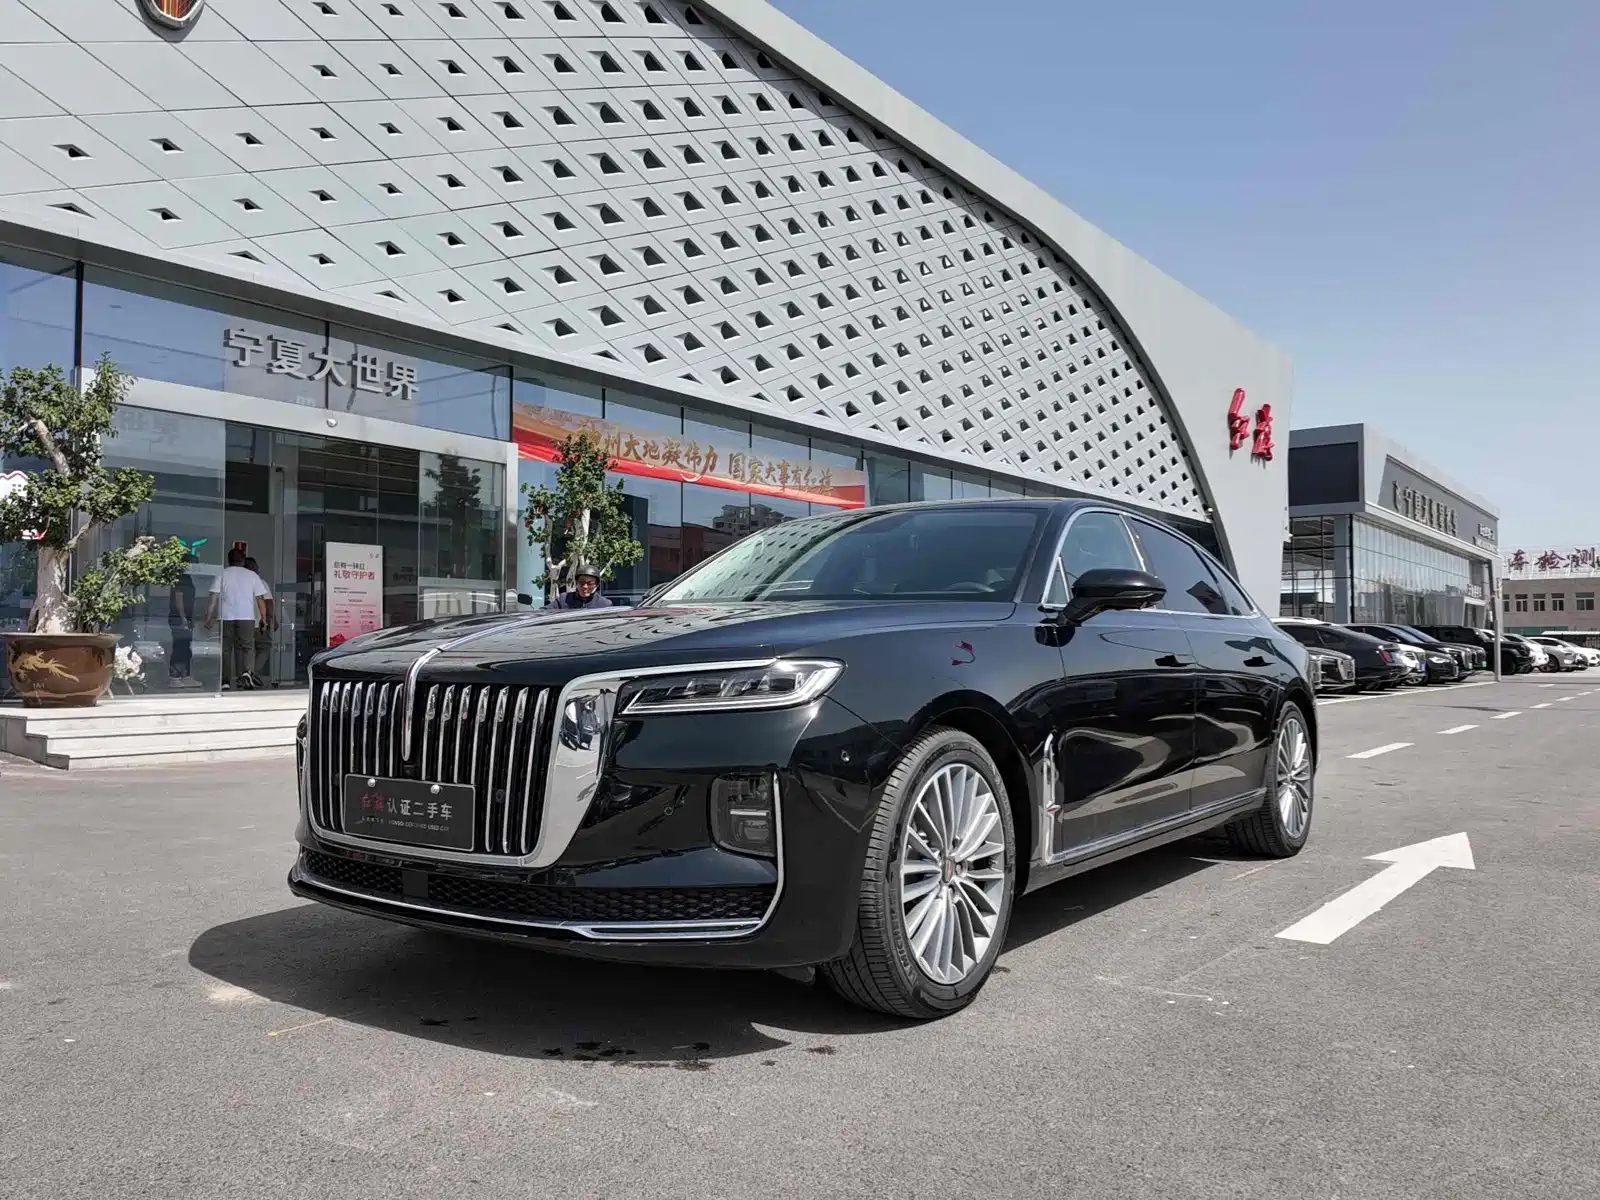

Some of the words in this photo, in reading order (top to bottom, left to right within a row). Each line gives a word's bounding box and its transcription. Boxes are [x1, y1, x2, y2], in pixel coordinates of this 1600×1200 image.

[223, 328, 420, 400] 宁夏大世界
[581, 420, 718, 475] 州大地凝伟力
[333, 570, 375, 580] 礼敬守护者
[387, 797, 453, 820] 认证二手车
